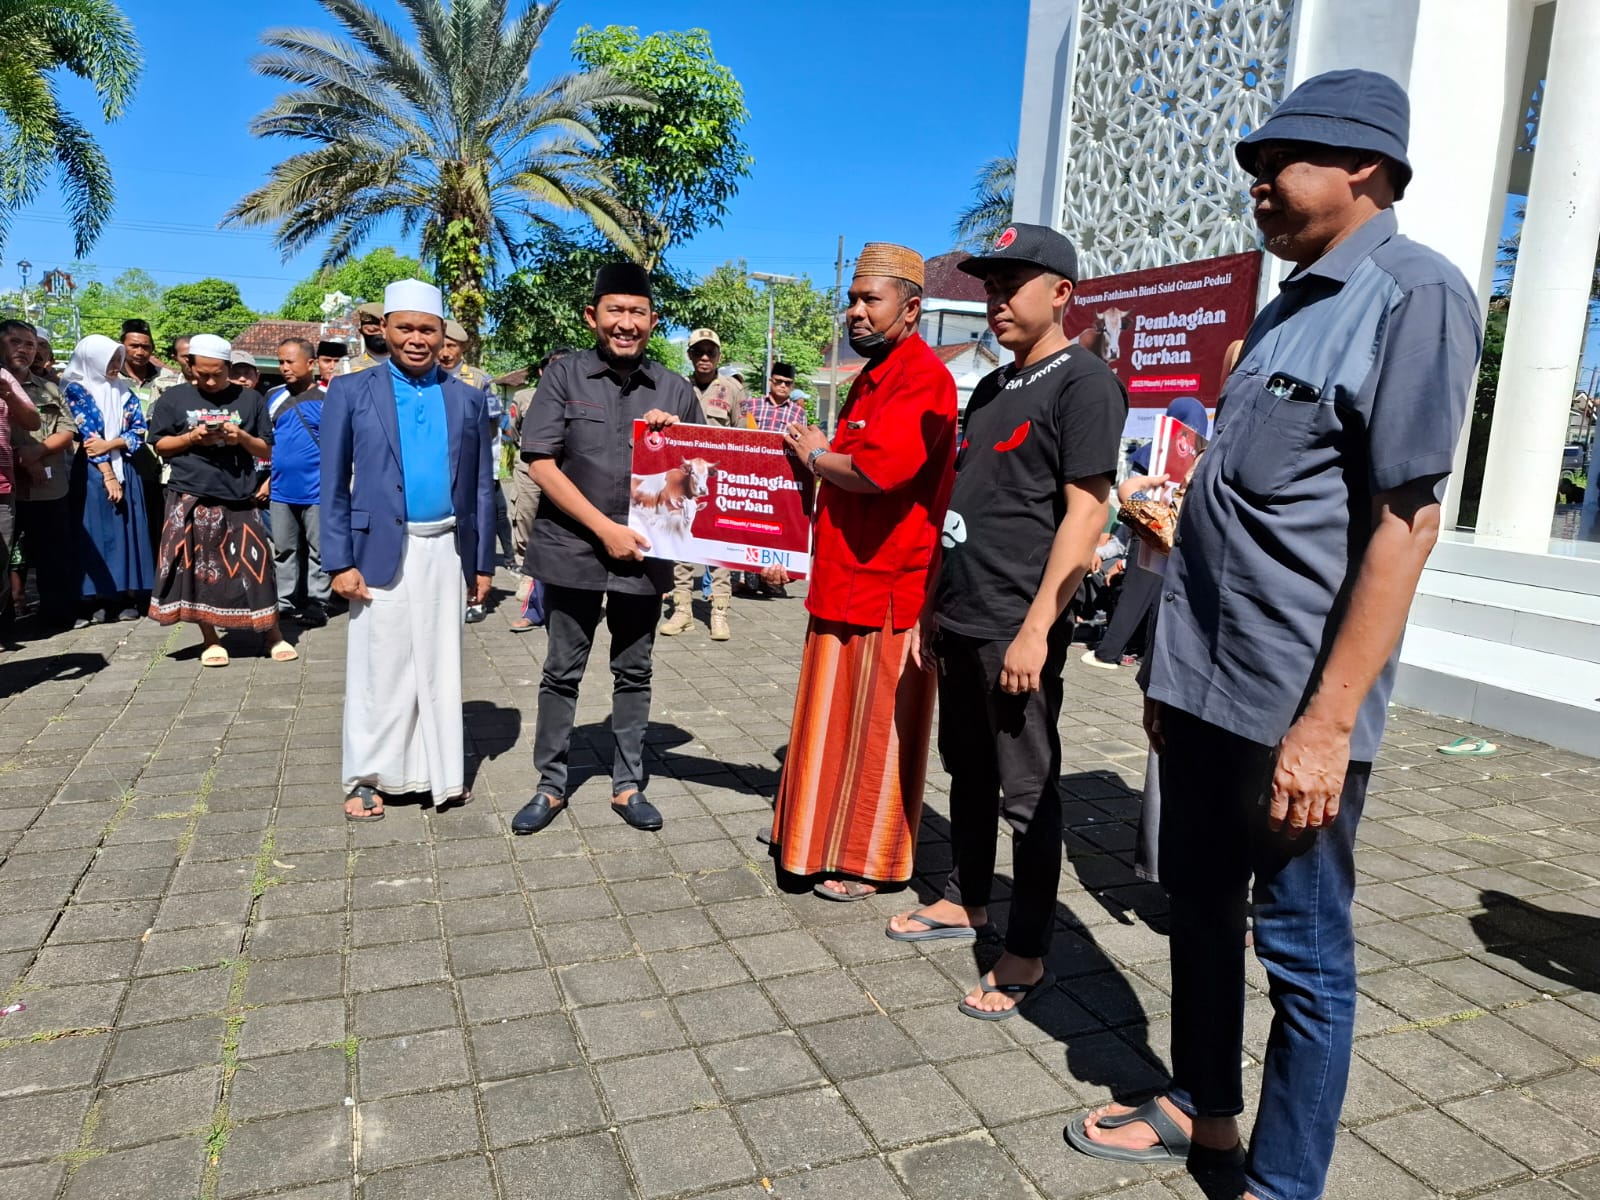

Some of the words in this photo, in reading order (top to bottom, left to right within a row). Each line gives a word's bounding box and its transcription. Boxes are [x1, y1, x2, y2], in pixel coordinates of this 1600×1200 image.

[1074, 294, 1103, 306] Yayasan
[1103, 287, 1138, 302] Fathimah
[1139, 284, 1157, 297] Binti
[1158, 282, 1175, 294] Said
[1176, 279, 1203, 292] Guzan
[1203, 273, 1232, 288] Peduli
[1134, 307, 1227, 332] Pembagian
[1133, 332, 1187, 349] Hewan
[1131, 347, 1191, 371] Qurban
[664, 437, 694, 447] Yayasan
[694, 440, 727, 450] Fathimah
[727, 443, 744, 452] Binti
[744, 445, 761, 453] Said
[717, 470, 804, 491] Pembagian
[716, 483, 769, 500] Hewan
[715, 495, 774, 514] Qurban
[761, 549, 790, 568] BNI
